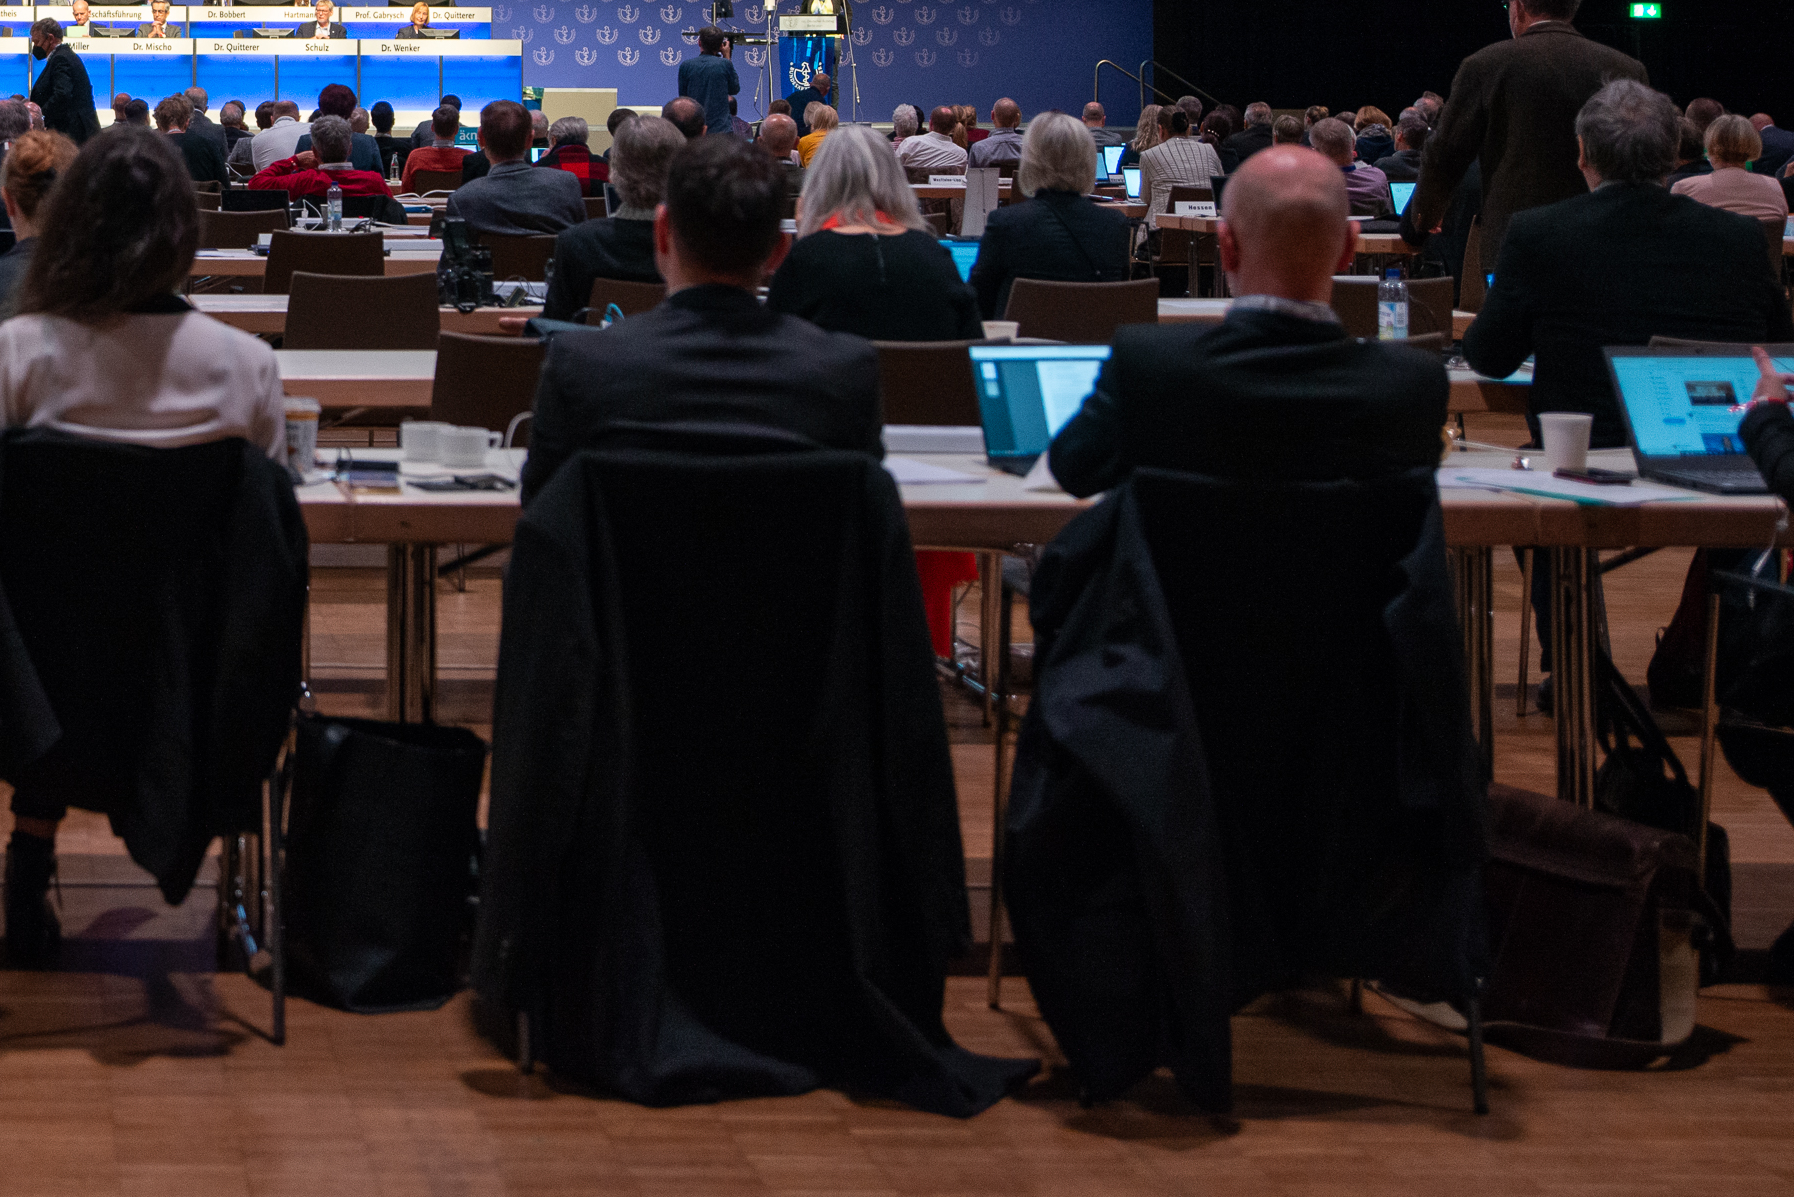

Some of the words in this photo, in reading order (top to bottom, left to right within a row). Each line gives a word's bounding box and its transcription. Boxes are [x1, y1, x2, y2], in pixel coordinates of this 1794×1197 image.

[90, 10, 142, 20] schäftsführung
[219, 10, 246, 18] Bobbert
[355, 11, 371, 19] Prof.
[373, 11, 405, 20] Gabrysch
[432, 11, 443, 19] Dr.
[444, 11, 476, 20] Quitterer
[133, 43, 144, 51] Dr.
[145, 42, 172, 51] Mischo
[214, 43, 224, 51] Dr.
[226, 43, 260, 52] Quitterer
[305, 43, 329, 52] Schulz
[381, 44, 392, 52] Dr.
[393, 44, 420, 52] Wenker
